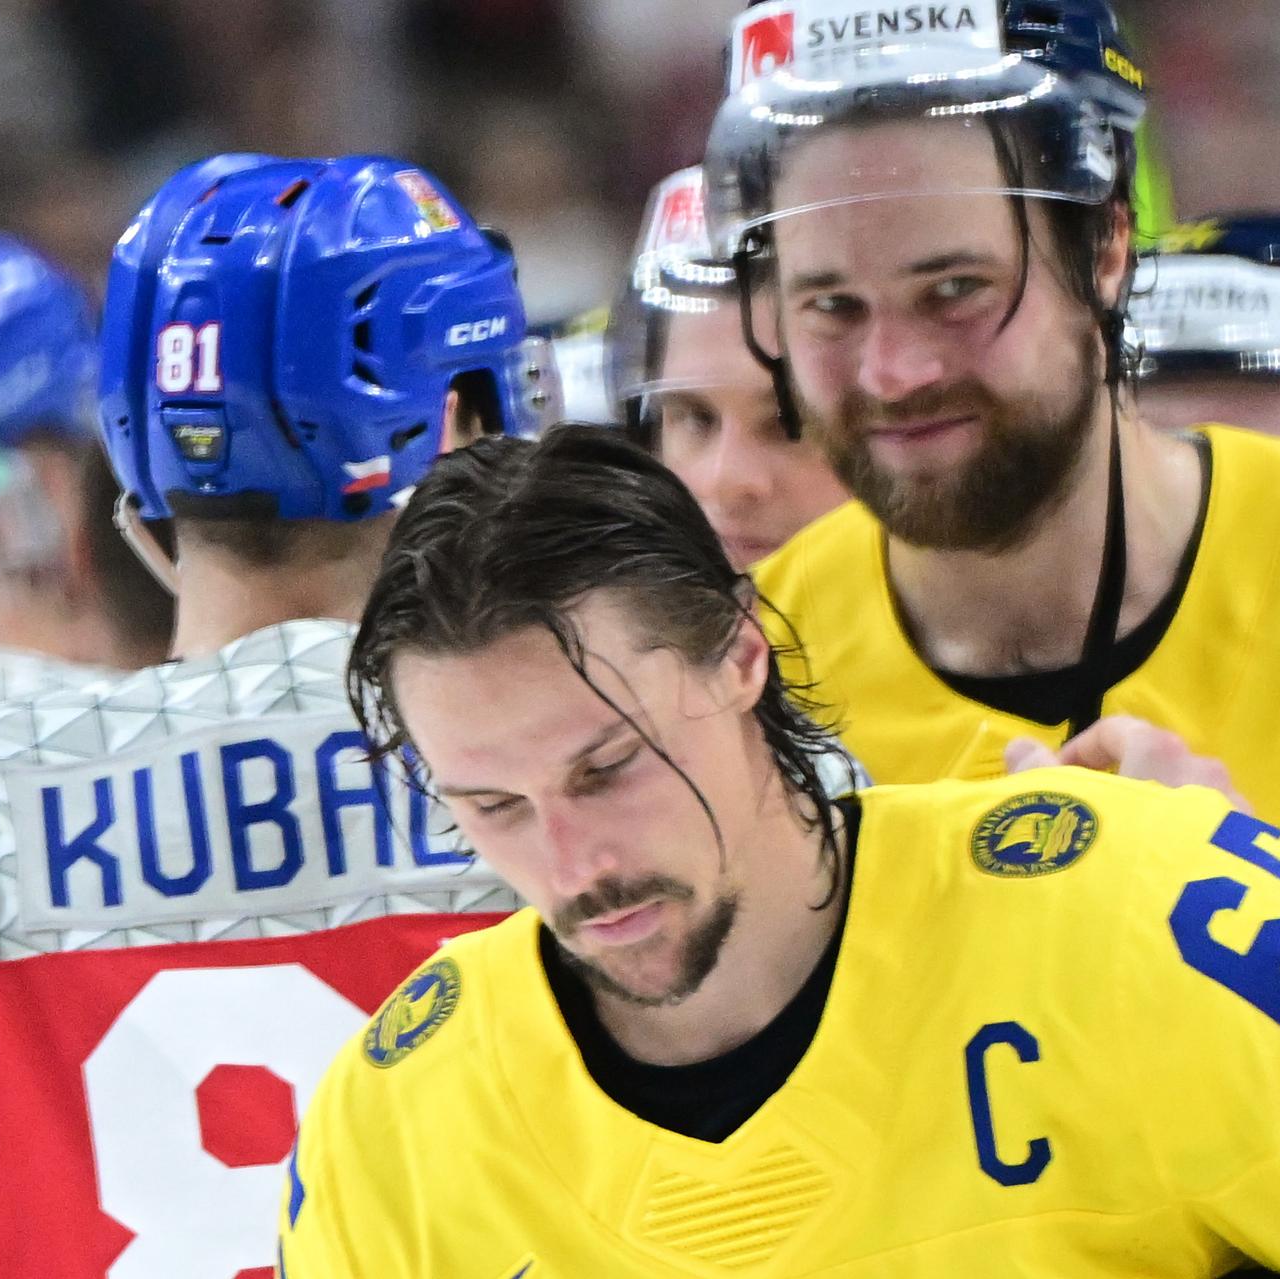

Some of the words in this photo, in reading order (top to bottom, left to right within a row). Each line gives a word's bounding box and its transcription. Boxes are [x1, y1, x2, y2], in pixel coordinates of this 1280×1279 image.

[807, 5, 977, 48] SVENSKA
[156, 320, 223, 394] 81
[446, 315, 508, 347] CCM
[964, 1020, 1054, 1187] C
